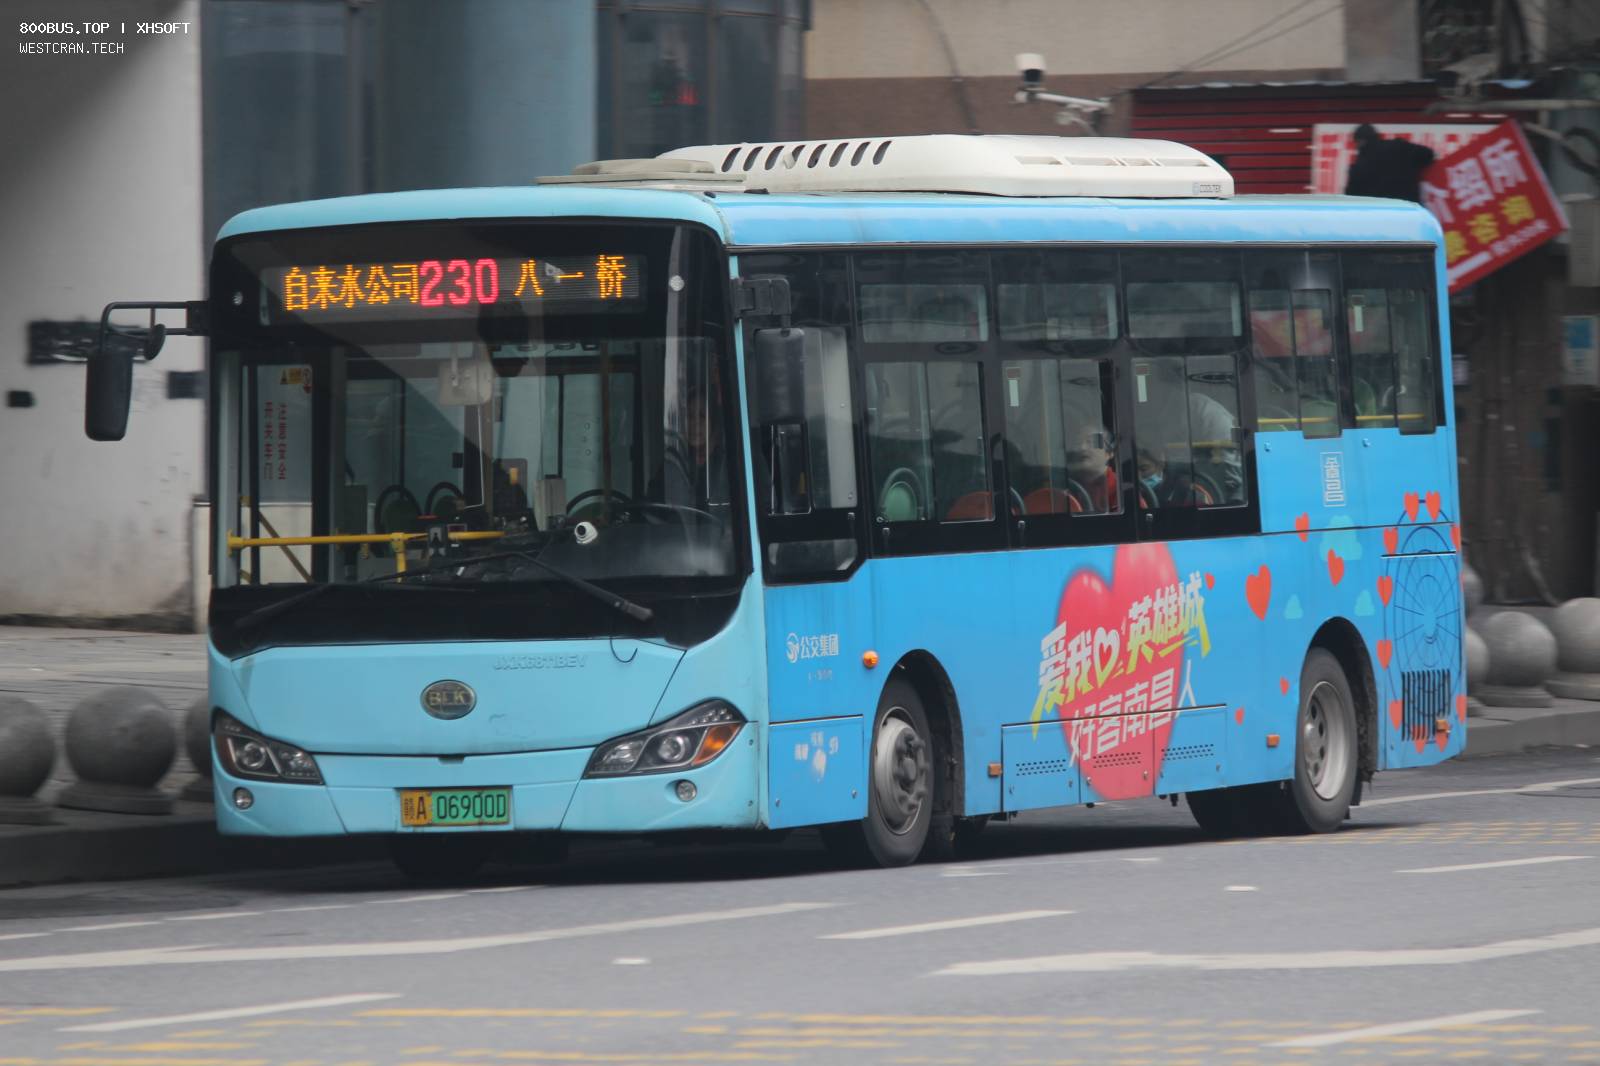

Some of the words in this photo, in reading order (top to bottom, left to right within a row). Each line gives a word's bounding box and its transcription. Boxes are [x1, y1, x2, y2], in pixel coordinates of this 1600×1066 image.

[284, 264, 420, 312] 自来水公司
[418, 258, 500, 307] 230
[1069, 658, 1197, 767] 好客南昌人
